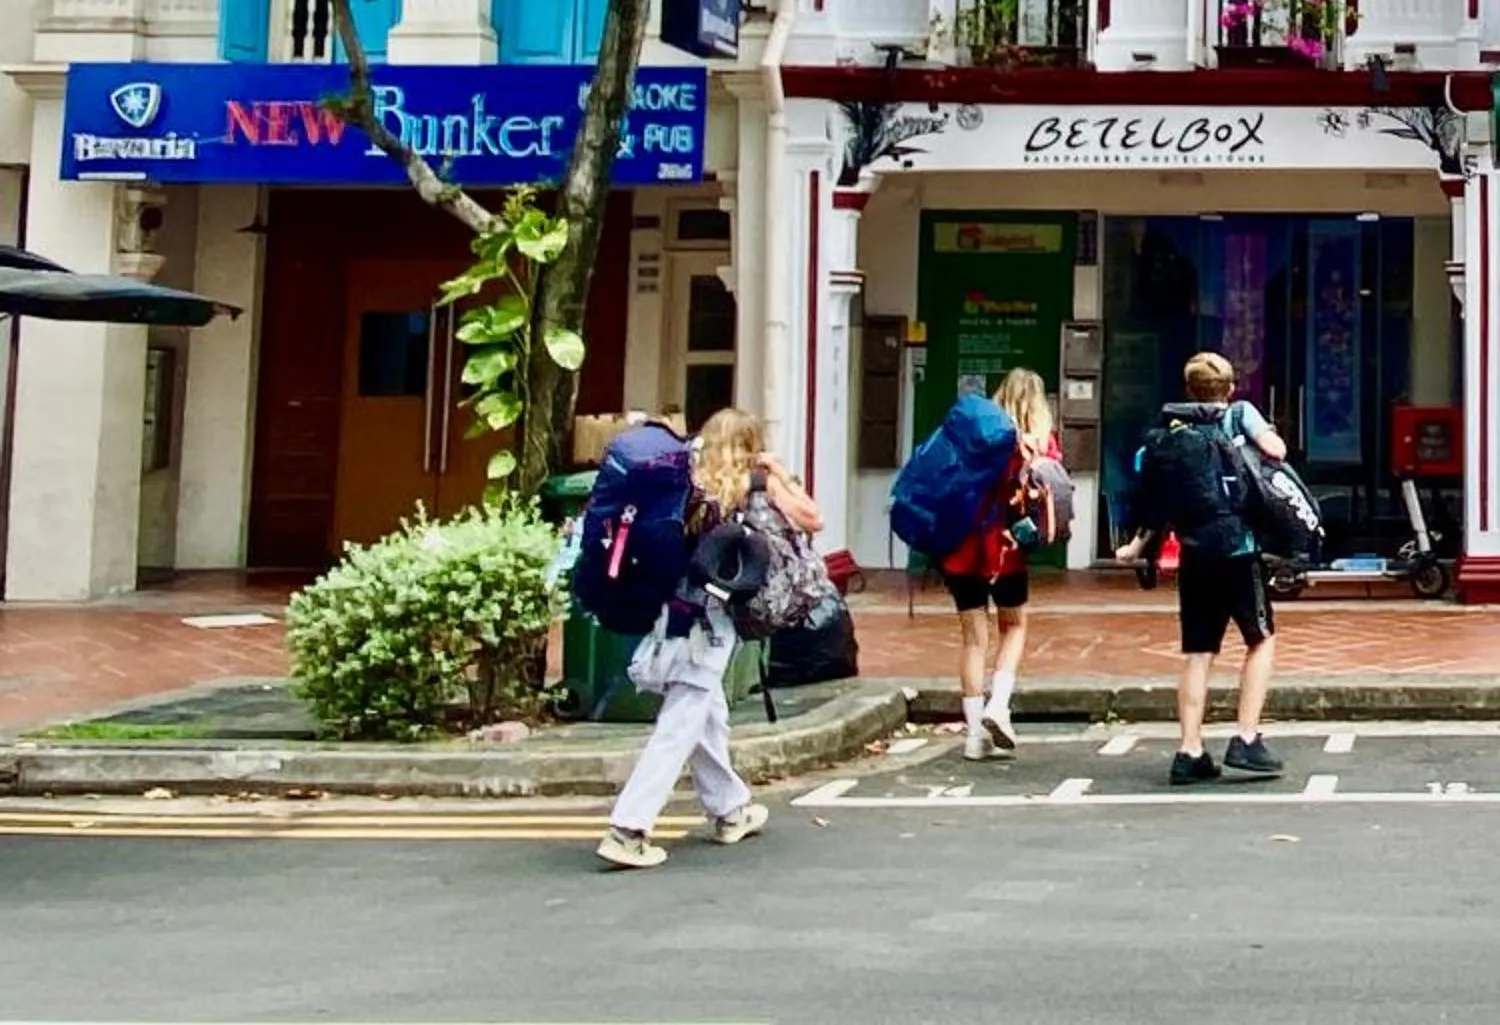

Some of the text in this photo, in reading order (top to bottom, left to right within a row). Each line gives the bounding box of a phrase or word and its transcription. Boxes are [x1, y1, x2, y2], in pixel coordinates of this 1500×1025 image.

[223, 100, 346, 146] NEW
[364, 84, 564, 158] Bunker
[643, 123, 695, 153] PUB
